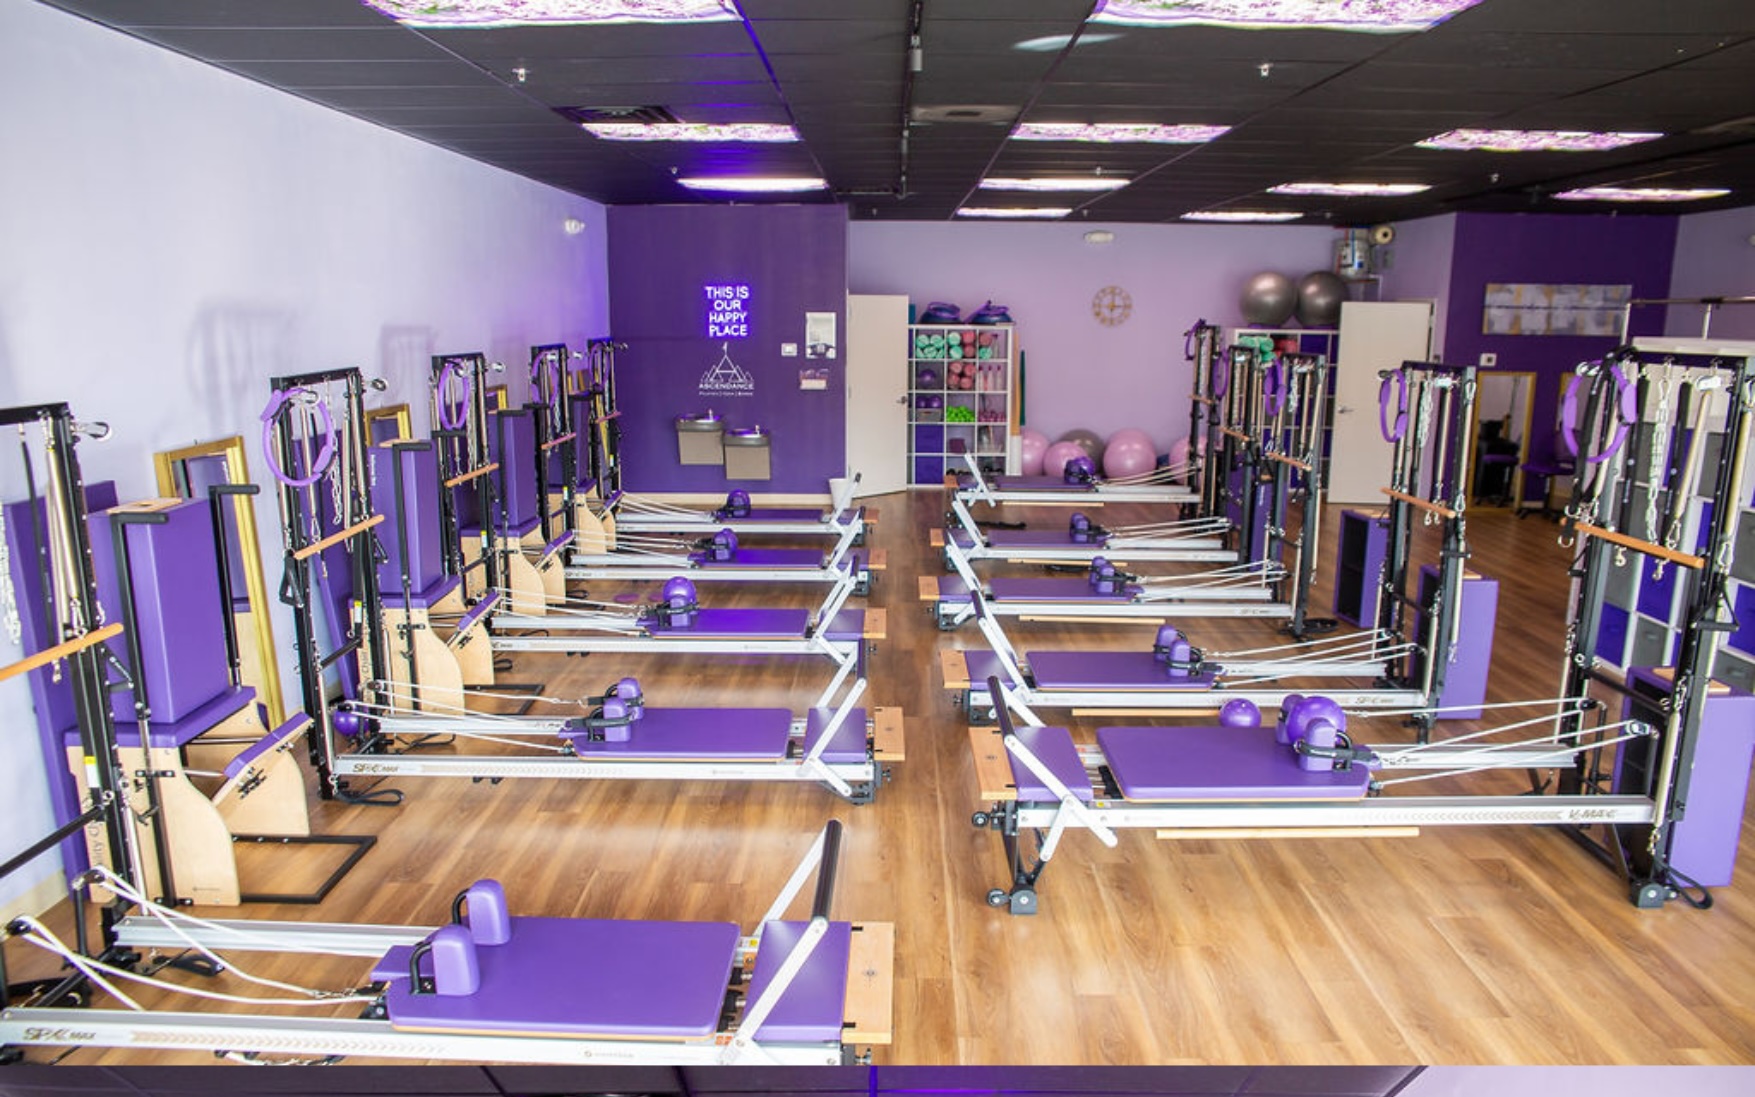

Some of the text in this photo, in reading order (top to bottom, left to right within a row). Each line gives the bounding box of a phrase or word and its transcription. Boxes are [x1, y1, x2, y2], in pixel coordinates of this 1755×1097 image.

[705, 286, 749, 299] THIS IS
[714, 300, 741, 311] OUR
[709, 312, 748, 323] HAPPY
[709, 324, 748, 337] PLACE
